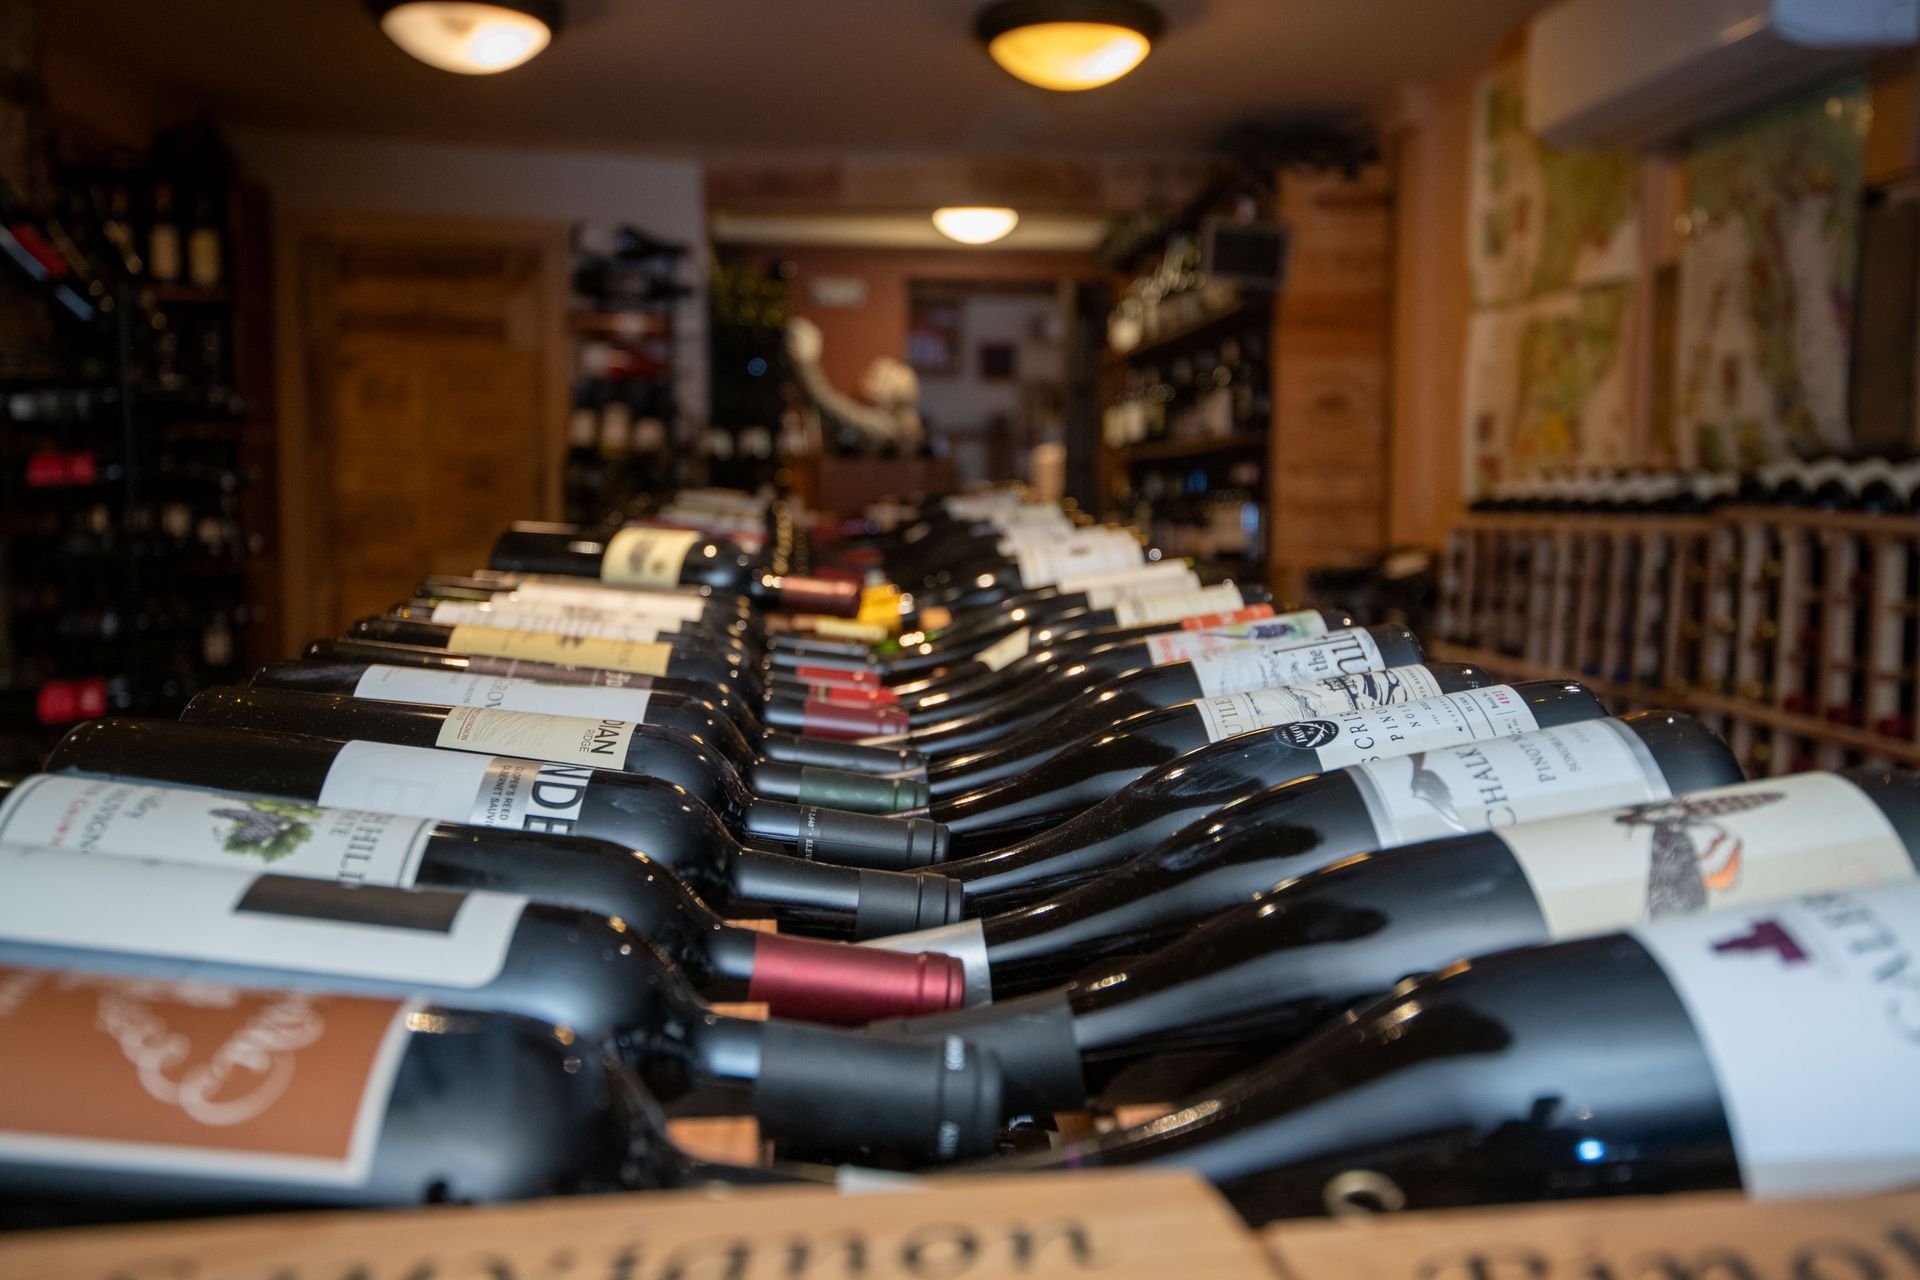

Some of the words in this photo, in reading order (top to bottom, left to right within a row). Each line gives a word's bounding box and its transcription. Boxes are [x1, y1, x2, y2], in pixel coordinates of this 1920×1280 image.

[1308, 649, 1328, 672] the
[579, 729, 596, 753] RIDGE
[499, 797, 513, 821] REED
